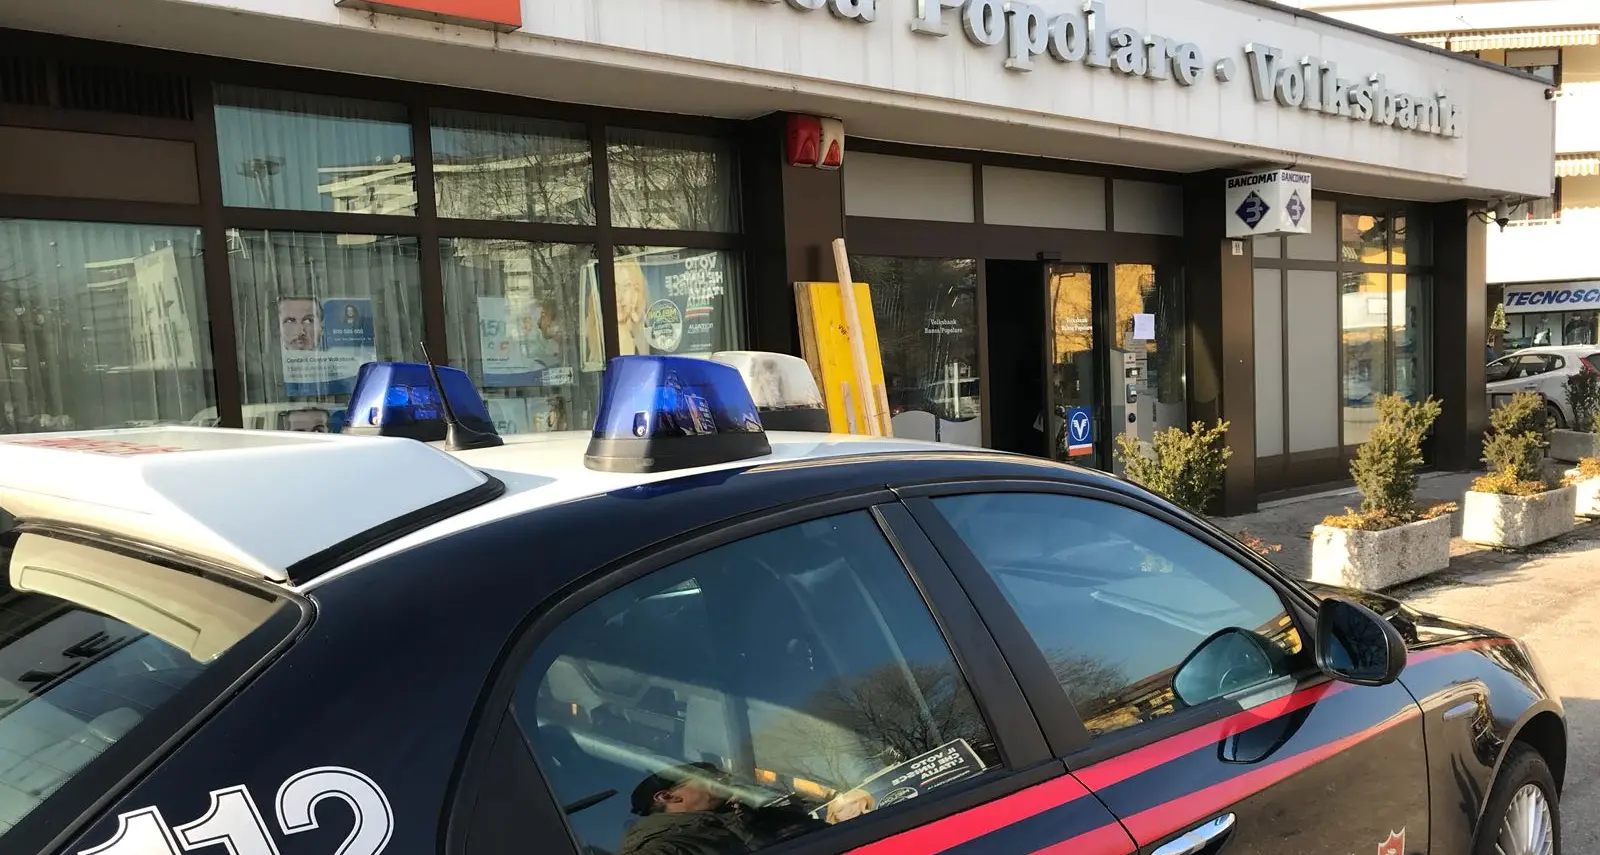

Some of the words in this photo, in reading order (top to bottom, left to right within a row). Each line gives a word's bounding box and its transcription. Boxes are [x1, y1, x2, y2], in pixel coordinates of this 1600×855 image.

[1244, 42, 1463, 138] Volksbank
[1228, 172, 1278, 188] BANCOMAT
[1281, 172, 1310, 183] BANCOMAT
[1505, 288, 1600, 306] TECNOSC
